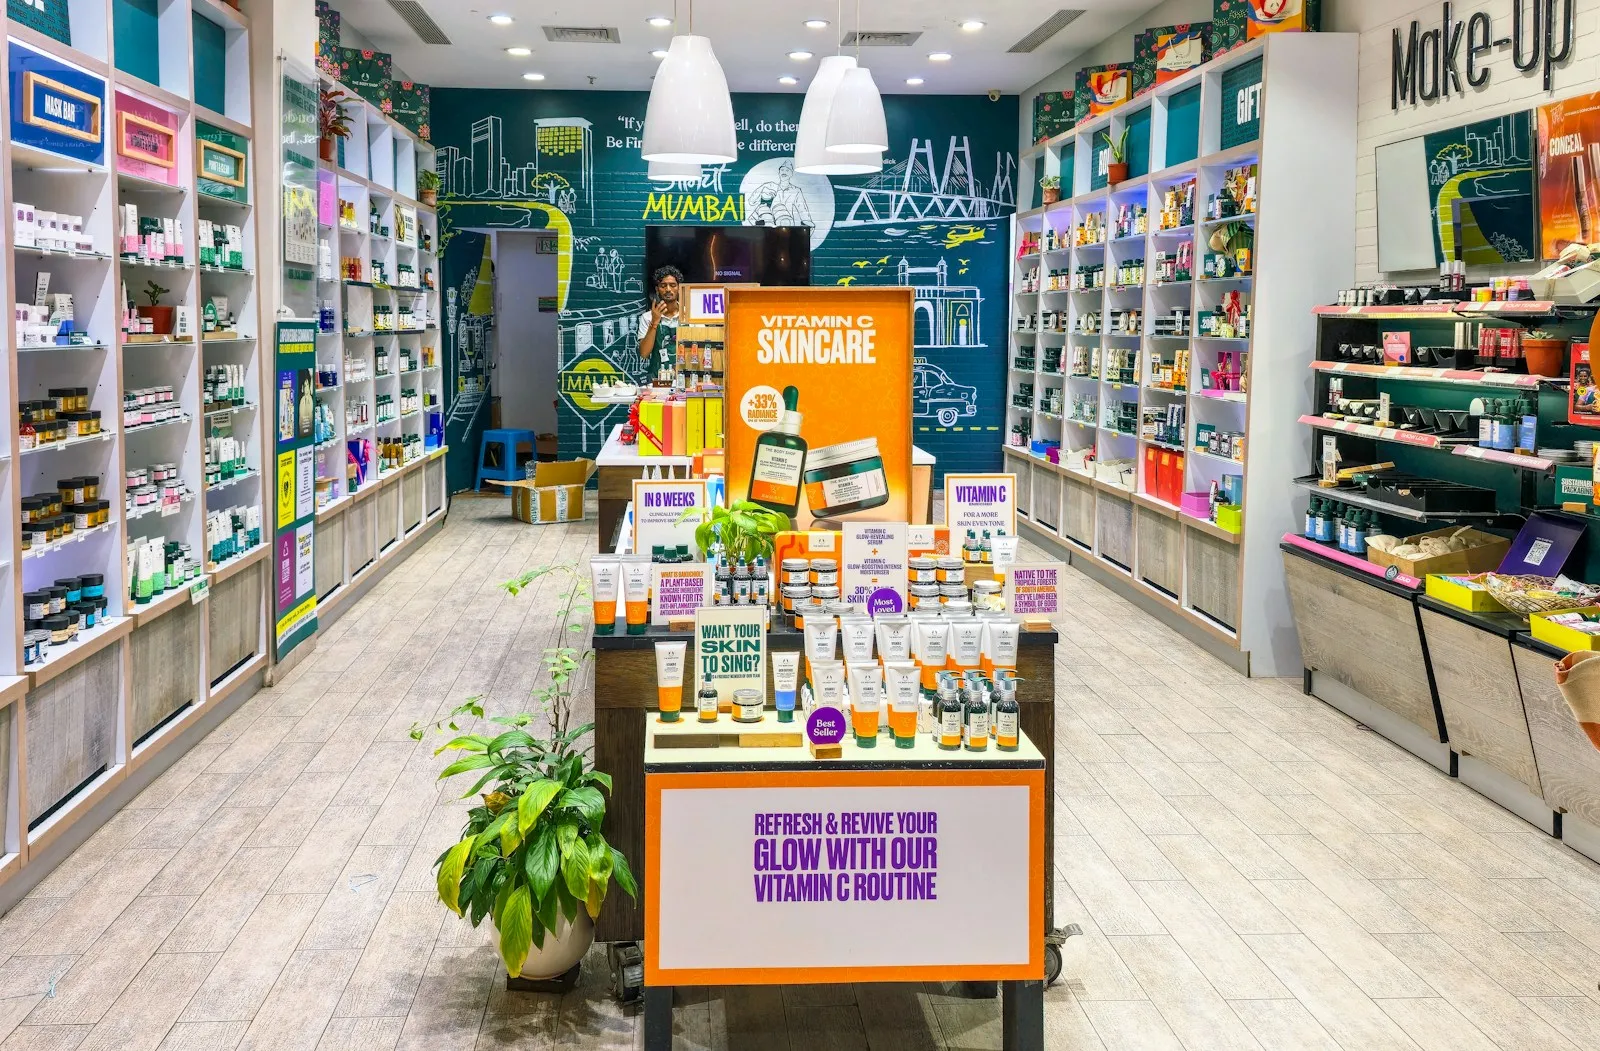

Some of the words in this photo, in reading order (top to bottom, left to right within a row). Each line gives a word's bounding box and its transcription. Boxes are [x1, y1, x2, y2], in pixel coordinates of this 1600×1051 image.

[45, 94, 62, 118] MASK
[63, 101, 75, 122] BAR
[756, 121, 772, 132] do
[606, 136, 623, 148] Be
[749, 139, 796, 152] differen
[1550, 132, 1584, 156] CONCEAL
[642, 192, 744, 221] MUMBAI
[761, 316, 851, 327] VITAMIN
[857, 316, 873, 327] C
[757, 329, 876, 364] SKINCARE
[748, 394, 777, 409] +33%
[747, 409, 777, 418] RADIANCE
[1561, 478, 1592, 487] SUSTAINABL
[645, 492, 654, 507] IN
[655, 492, 662, 507] 8
[663, 492, 695, 507] WEEKS
[956, 486, 997, 502] VITAMIN
[999, 486, 1006, 502] C
[1015, 571, 1036, 579] NATIVE
[1037, 570, 1044, 578] TO
[1046, 570, 1057, 578] THE
[666, 578, 704, 587] PLANT-BASED
[683, 594, 693, 602] FOR
[855, 587, 873, 595] 30%
[848, 595, 864, 603] SKIN
[702, 625, 731, 638] WANT
[734, 624, 760, 637] YOUR
[701, 640, 760, 653] SKIN
[701, 655, 718, 673] TO
[721, 654, 760, 672] SING?
[816, 719, 836, 727] Best
[814, 728, 838, 736] Seller
[755, 813, 822, 835] REFRESH
[826, 813, 838, 835] &
[842, 812, 894, 834] REVIVE
[897, 812, 937, 834] YOUR
[754, 838, 822, 871] GLOW
[826, 838, 886, 870] WITH
[891, 837, 937, 869] OUR
[754, 874, 833, 902] VITAMIN
[837, 873, 850, 901] C
[854, 872, 937, 900] ROUTINE
